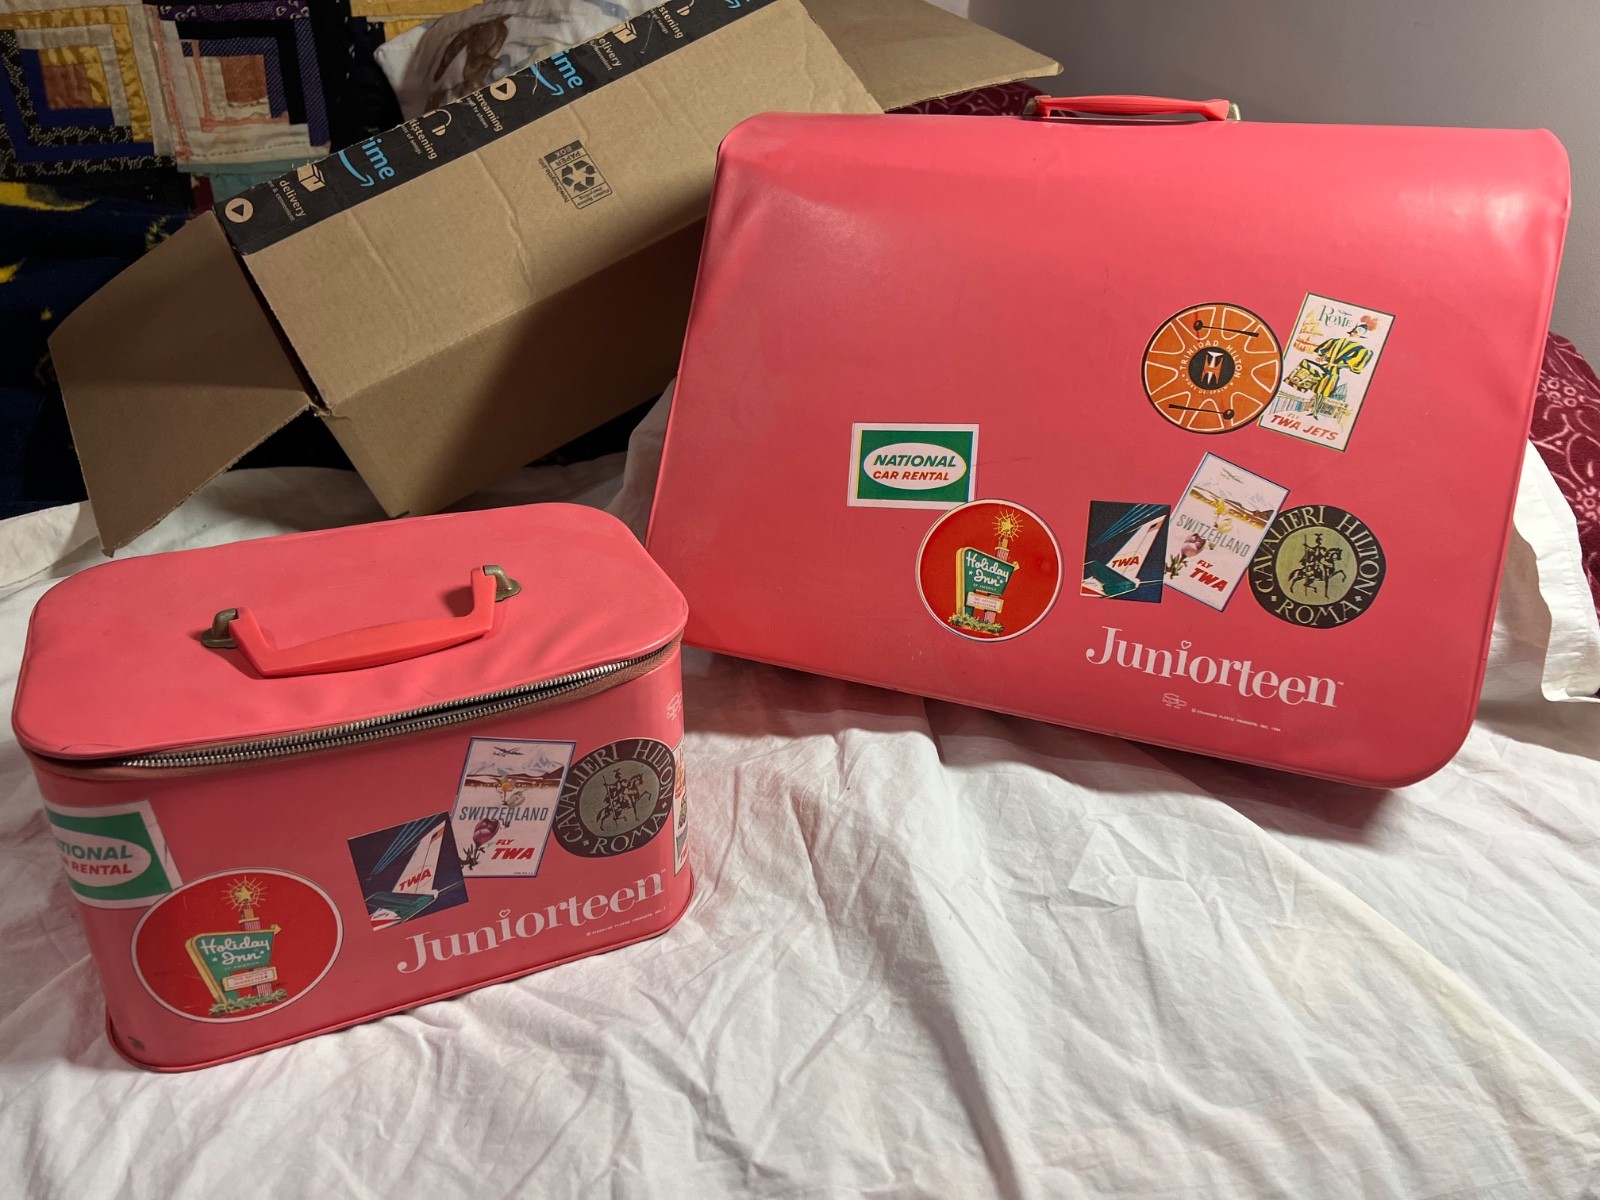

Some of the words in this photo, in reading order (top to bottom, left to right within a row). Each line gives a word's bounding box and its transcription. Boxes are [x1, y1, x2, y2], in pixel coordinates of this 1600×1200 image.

[362, 137, 395, 180] ime
[554, 146, 573, 157] BOX
[279, 180, 306, 217] delivery
[1180, 340, 1219, 370] TRINIDAD
[1225, 345, 1242, 378] HILTON
[1270, 414, 1301, 430] TWA
[1303, 425, 1339, 441] JETS
[873, 454, 957, 468] NATIONAL
[872, 470, 899, 480] CAR
[901, 471, 950, 481] RENTAL
[1176, 514, 1251, 558] SWITZERLAND
[1253, 505, 1326, 593] CAVALIERI
[1336, 512, 1380, 595] HILTON
[965, 551, 1009, 582] Holiday
[1111, 556, 1140, 568] TWA
[1196, 559, 1214, 568] FLY
[973, 569, 1000, 587] Inn
[1189, 568, 1229, 592] TWA
[1274, 599, 1362, 626] ROMA
[1085, 626, 1338, 708] Juniorteen
[555, 743, 619, 844] CAVALIERI
[631, 740, 674, 800] HILTON
[459, 806, 549, 821] SWITZERLAND
[495, 838, 515, 846] FLY
[589, 812, 668, 855] ROMA
[491, 847, 535, 860] TWA
[71, 860, 133, 876] RENTAL
[399, 868, 432, 891] TWA
[397, 872, 666, 974] Juniorteen
[200, 936, 271, 956] Holiday
[221, 951, 262, 965] Inn
